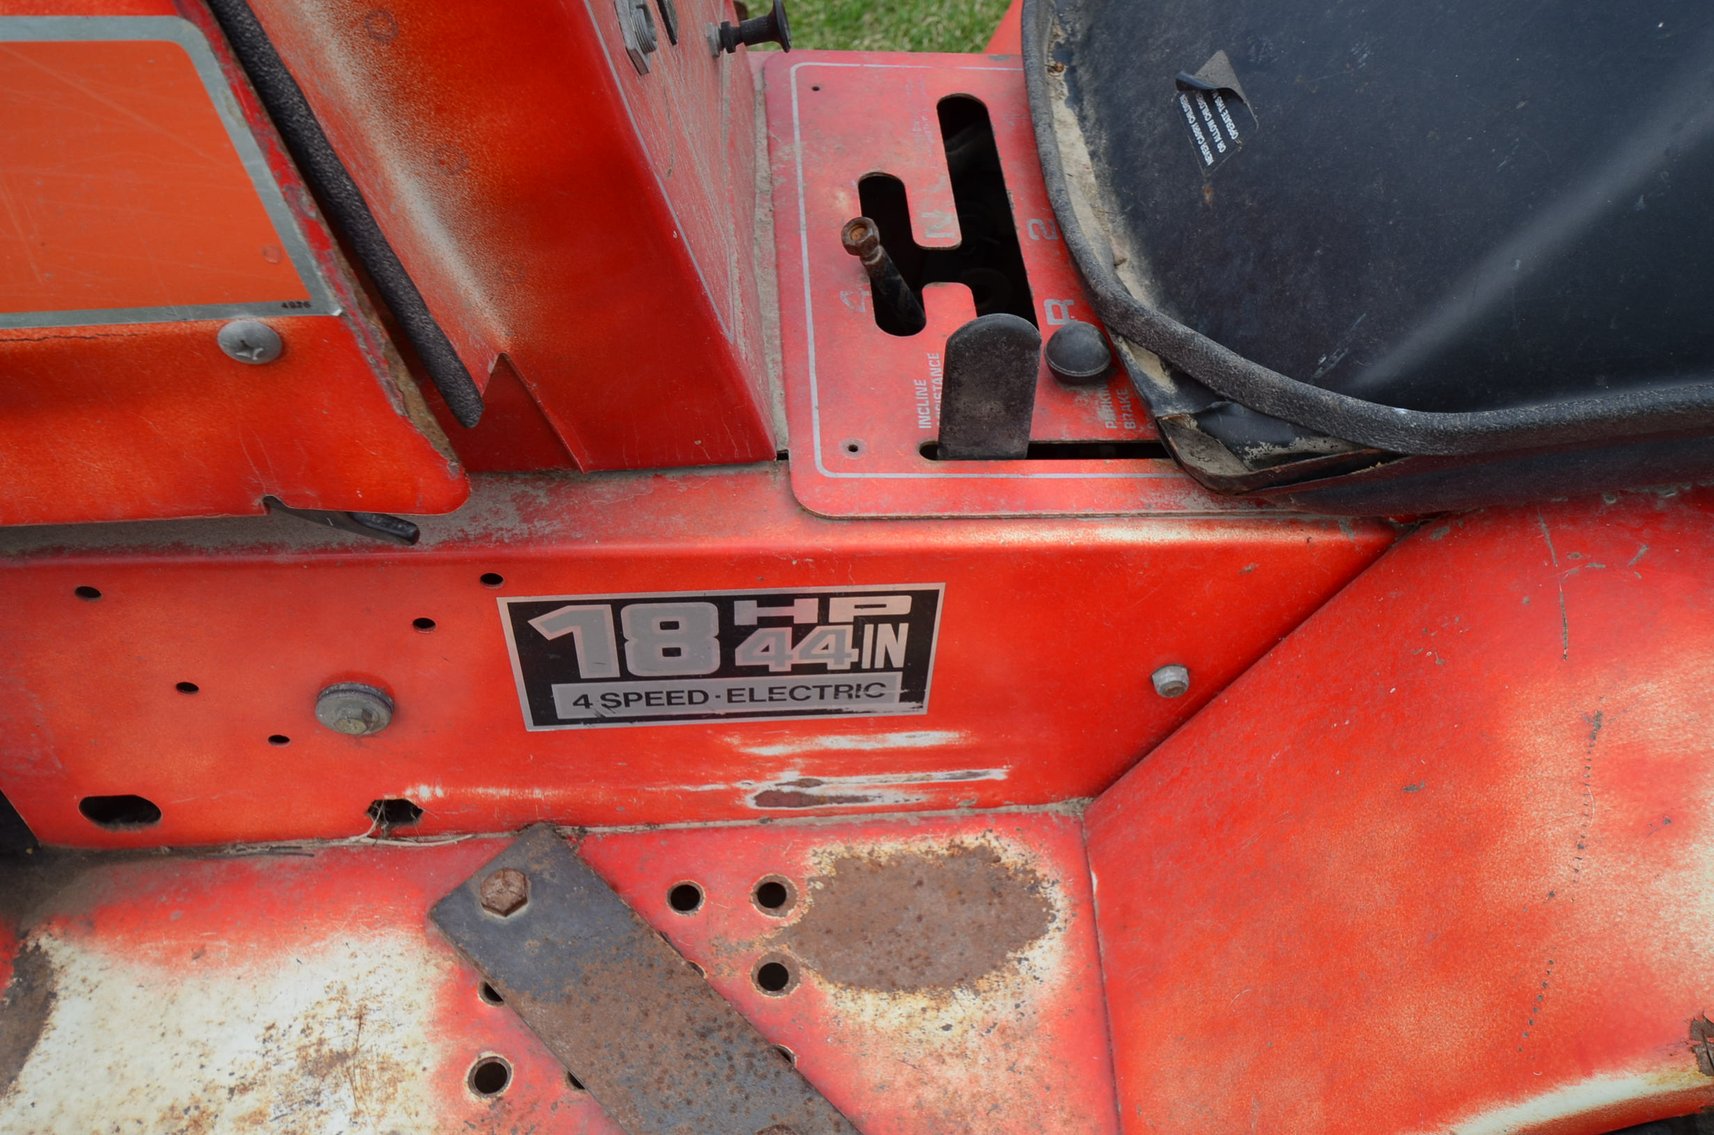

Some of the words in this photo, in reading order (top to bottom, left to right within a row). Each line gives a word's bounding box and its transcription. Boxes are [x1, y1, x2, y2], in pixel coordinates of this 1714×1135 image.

[1214, 96, 1226, 113] THIS
[1191, 122, 1205, 145] CARRY
[1207, 119, 1222, 143] ALLOW
[1220, 109, 1239, 139] OPERATE
[1200, 142, 1214, 166] NEVER
[1217, 140, 1226, 153] OR
[1026, 218, 1059, 241] 2
[1043, 298, 1078, 326] R
[914, 379, 932, 429] INCLINE
[527, 601, 720, 679] 18
[733, 595, 912, 625] HP
[572, 693, 593, 709] 4
